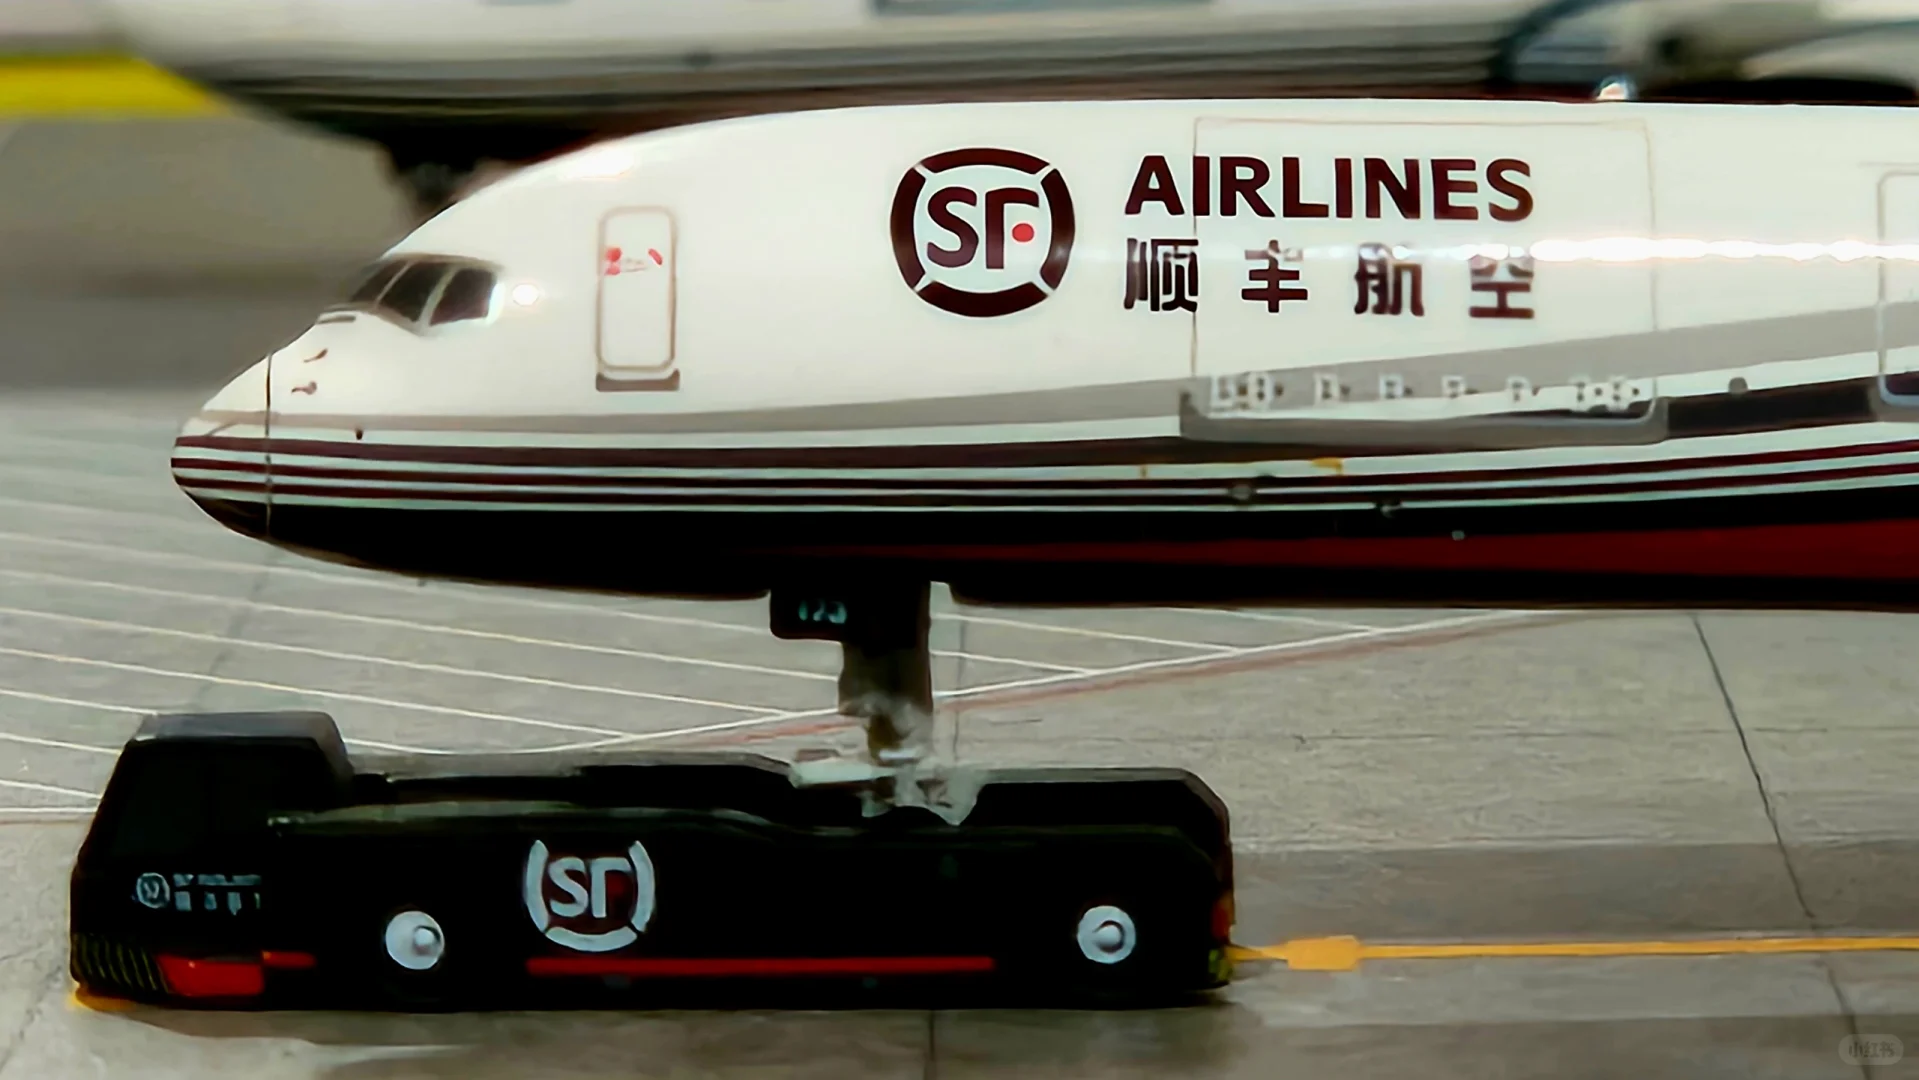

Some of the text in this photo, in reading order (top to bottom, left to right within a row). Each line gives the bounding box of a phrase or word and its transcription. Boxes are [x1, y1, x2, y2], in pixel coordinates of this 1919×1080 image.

[926, 185, 1040, 270] SF
[1124, 154, 1534, 222] AIRLINES
[1123, 237, 1535, 320] 顺丰航空
